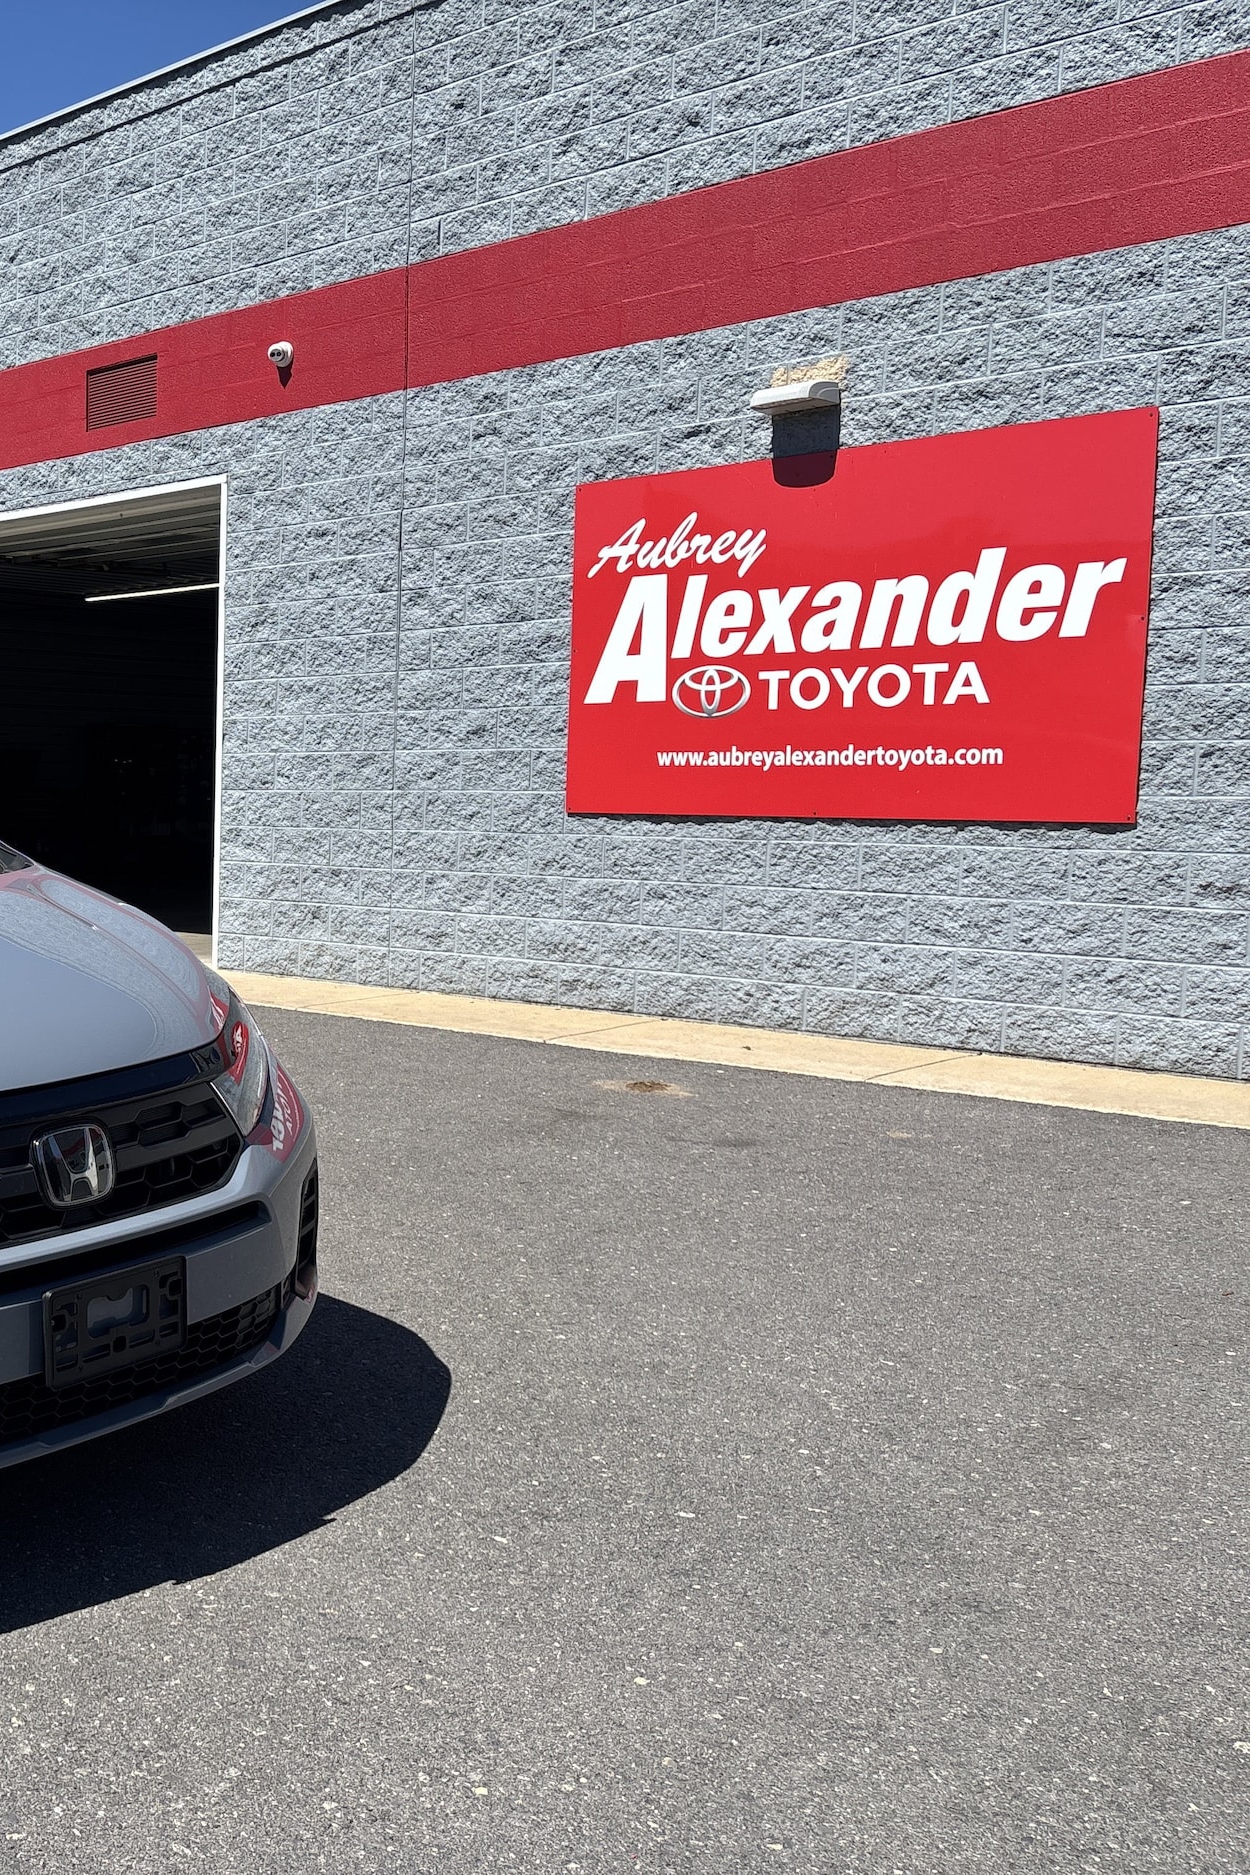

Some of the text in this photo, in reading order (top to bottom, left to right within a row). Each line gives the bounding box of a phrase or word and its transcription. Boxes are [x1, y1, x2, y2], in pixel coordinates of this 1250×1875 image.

[587, 511, 767, 579] Aubrey
[583, 546, 1129, 705] Alexander
[758, 661, 990, 711] TOYOTA
[656, 744, 1004, 772] www.aubreyalexandertoyota.com
